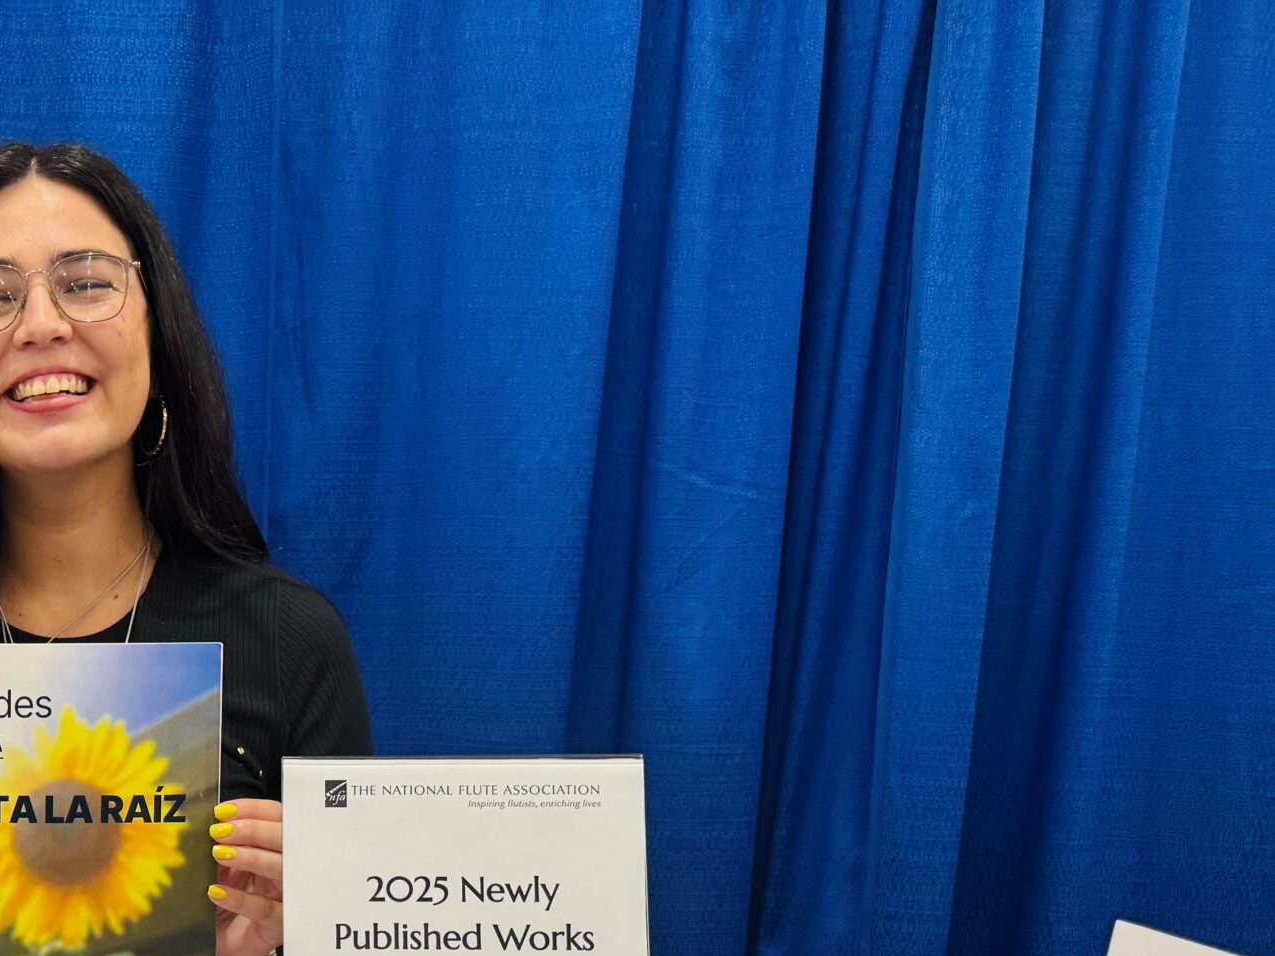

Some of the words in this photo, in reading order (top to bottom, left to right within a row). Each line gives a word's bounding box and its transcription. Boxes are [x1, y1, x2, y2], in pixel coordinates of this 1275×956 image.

[351, 784, 376, 795] THE
[382, 784, 453, 796] NATIONAL
[458, 784, 498, 796] FLUTE
[503, 784, 601, 796] ASSOCIATION
[44, 794, 93, 824] LA
[101, 786, 186, 823] RAÍZ
[468, 800, 506, 809] Inspiring
[507, 800, 538, 808] flutists,
[540, 800, 580, 809] enriching
[582, 800, 601, 808] lives
[366, 876, 449, 906] 2025
[461, 875, 560, 911] Newly
[335, 923, 482, 950] Published
[492, 923, 595, 951] Works
